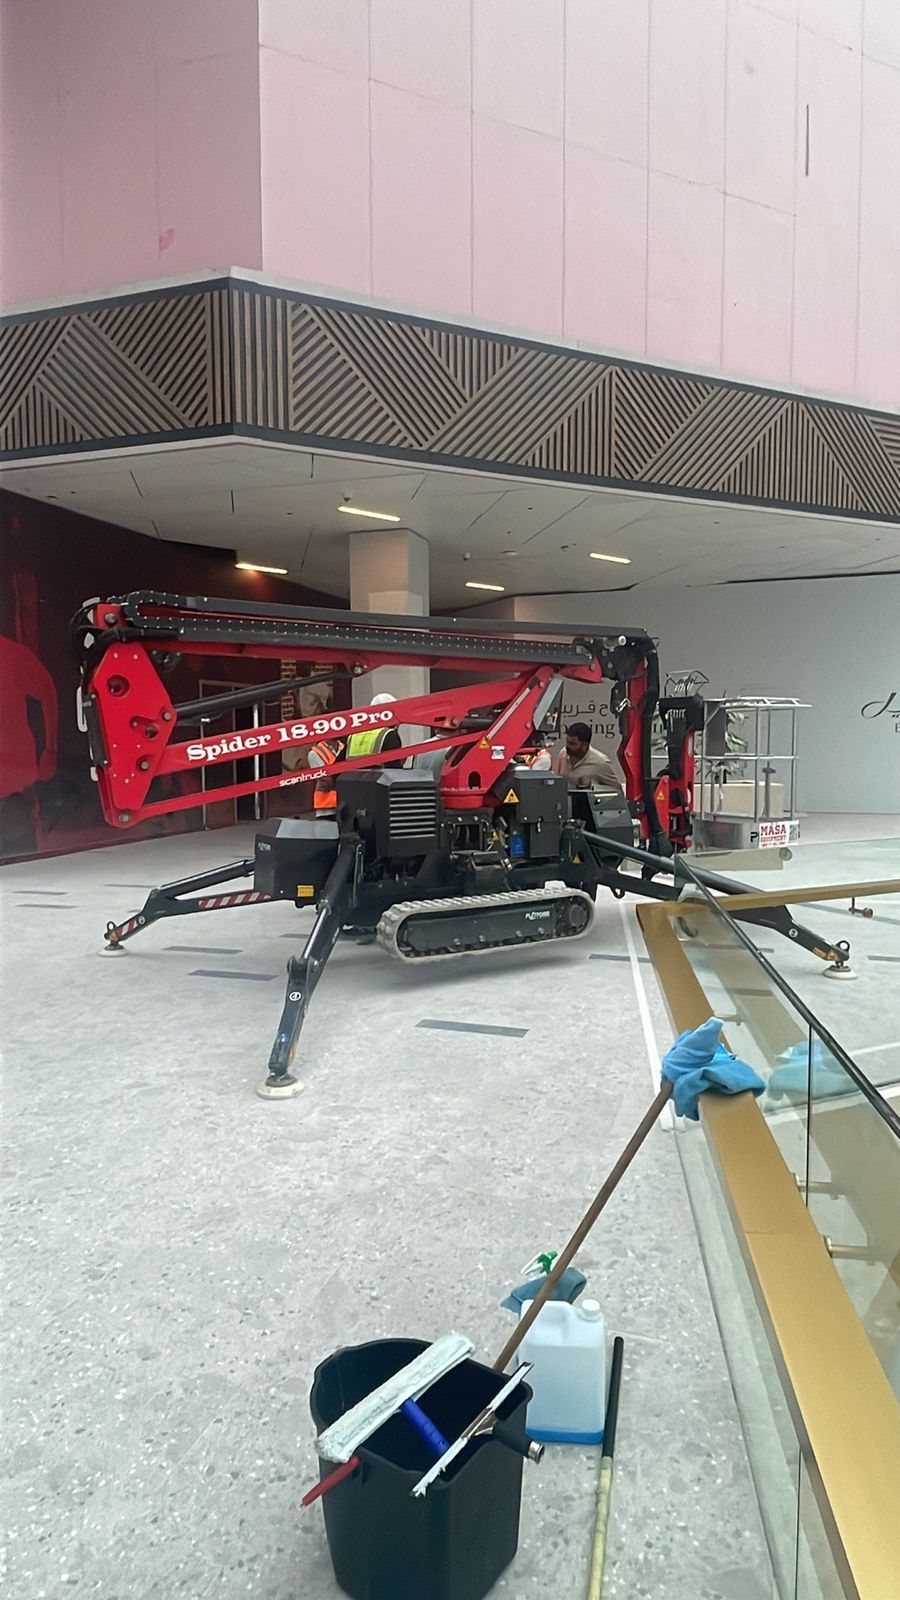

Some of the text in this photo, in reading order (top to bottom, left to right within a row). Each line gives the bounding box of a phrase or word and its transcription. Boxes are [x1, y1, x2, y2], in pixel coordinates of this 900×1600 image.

[186, 710, 393, 762] Spider 18.90 Pro
[279, 770, 327, 787] scantruck
[760, 824, 787, 836] MASA
